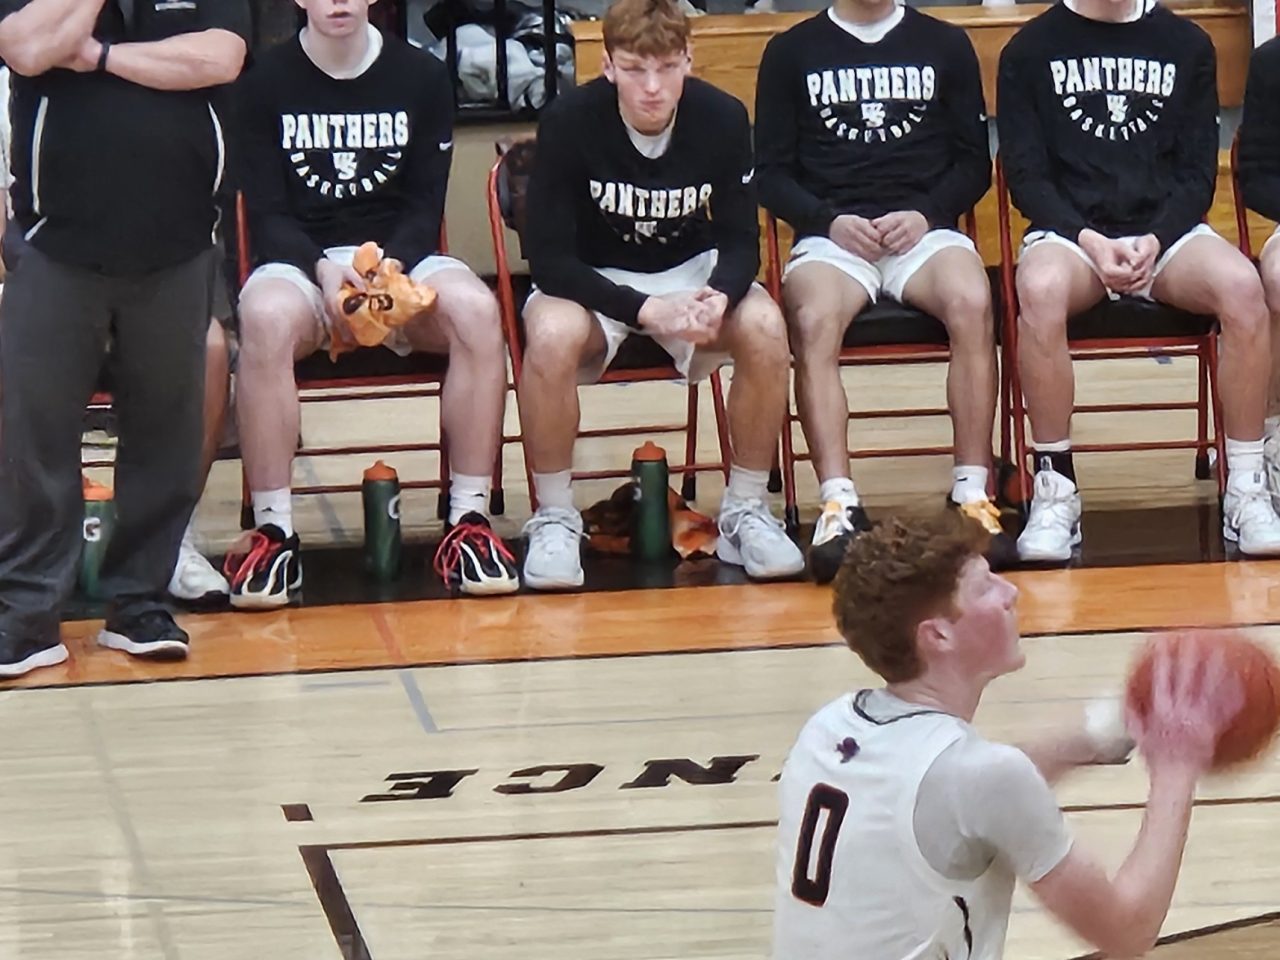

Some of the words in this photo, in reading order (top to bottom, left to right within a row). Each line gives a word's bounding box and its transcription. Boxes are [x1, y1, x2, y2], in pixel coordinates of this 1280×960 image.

[807, 65, 935, 107] PANTHERS
[1050, 57, 1176, 97] PANTHERS
[282, 111, 409, 149] PANTHERS
[791, 782, 850, 908] 0
